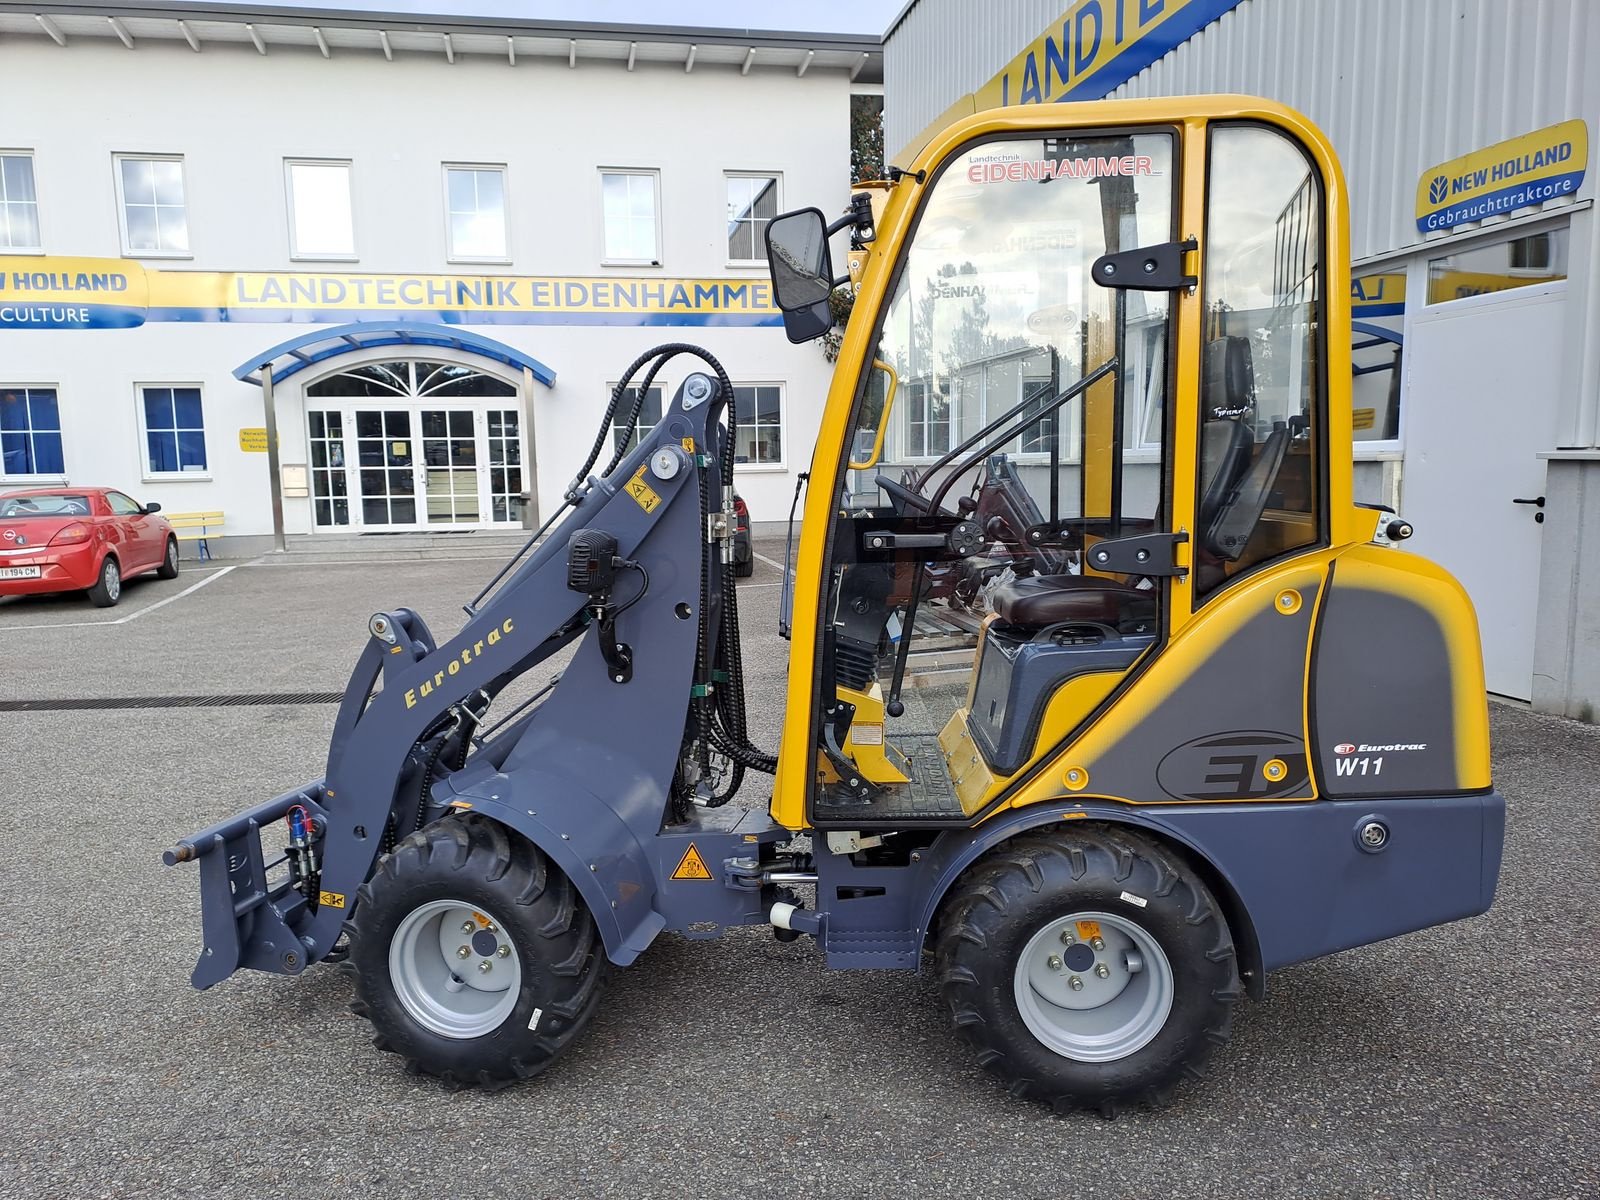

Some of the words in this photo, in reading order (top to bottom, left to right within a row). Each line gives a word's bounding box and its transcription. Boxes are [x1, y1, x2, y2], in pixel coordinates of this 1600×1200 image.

[967, 155, 1153, 184] EIDENHAMMER
[968, 153, 1021, 164] Landtechnik
[1451, 167, 1489, 195] NEW
[1491, 141, 1573, 183] HOLLAND
[1427, 178, 1572, 230] Gebrauchttraktore
[12, 272, 128, 291] HOLLAND
[236, 276, 521, 307] LANDTECHNIK
[530, 281, 779, 310] EIDENHAMME
[0, 307, 91, 323] CULTURE
[403, 618, 515, 710] Eurotrac
[1357, 743, 1428, 753] Eurotrac
[1335, 756, 1384, 777] W11
